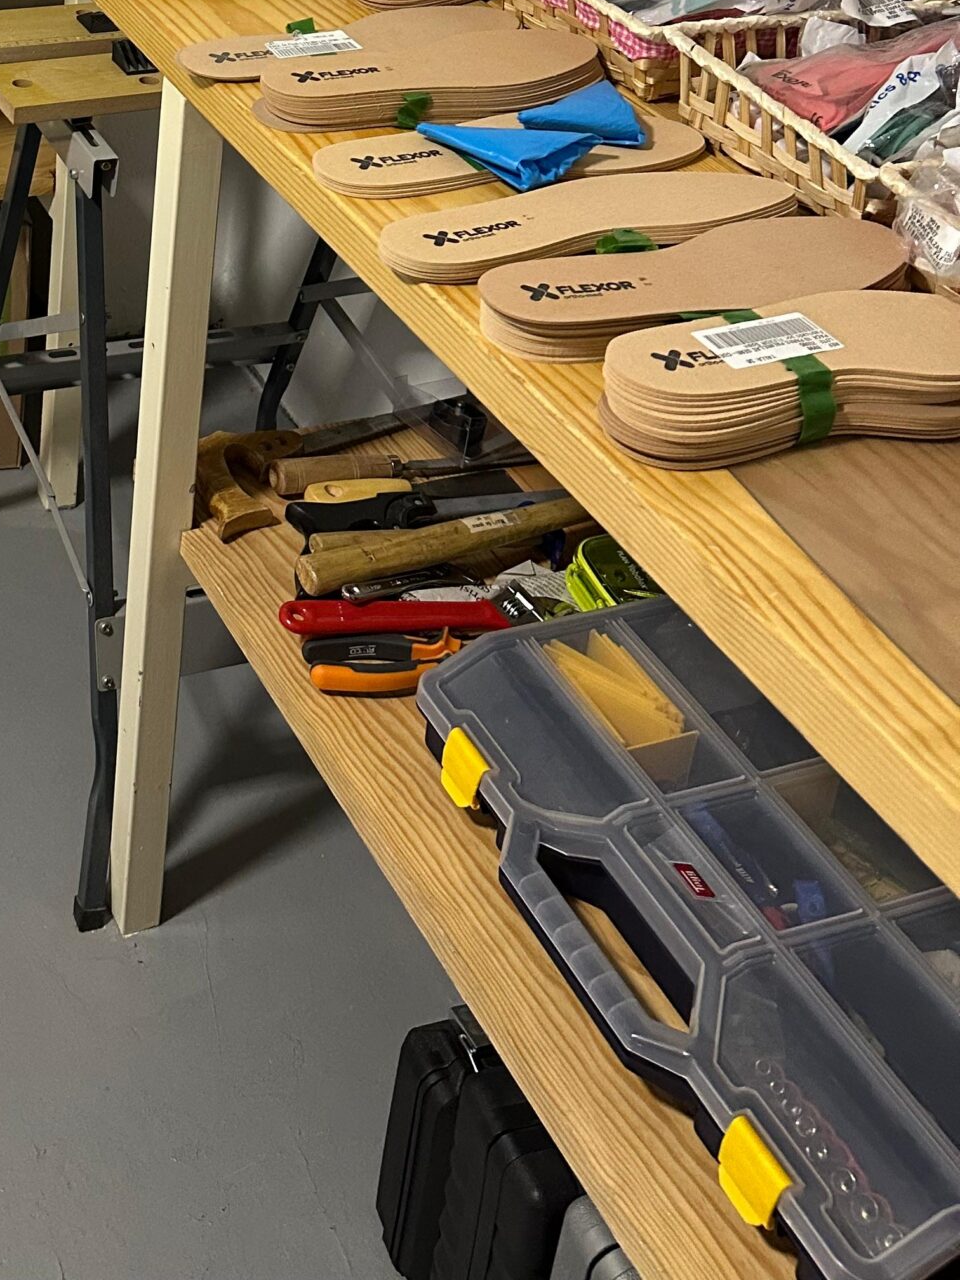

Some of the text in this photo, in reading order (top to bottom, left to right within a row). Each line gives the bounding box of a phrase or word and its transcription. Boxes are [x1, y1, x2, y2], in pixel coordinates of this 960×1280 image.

[319, 66, 381, 79] FLEXOR
[378, 149, 444, 164] FLEXOR
[453, 220, 522, 239] FLEXOR
[555, 281, 637, 295] FLEXOR
